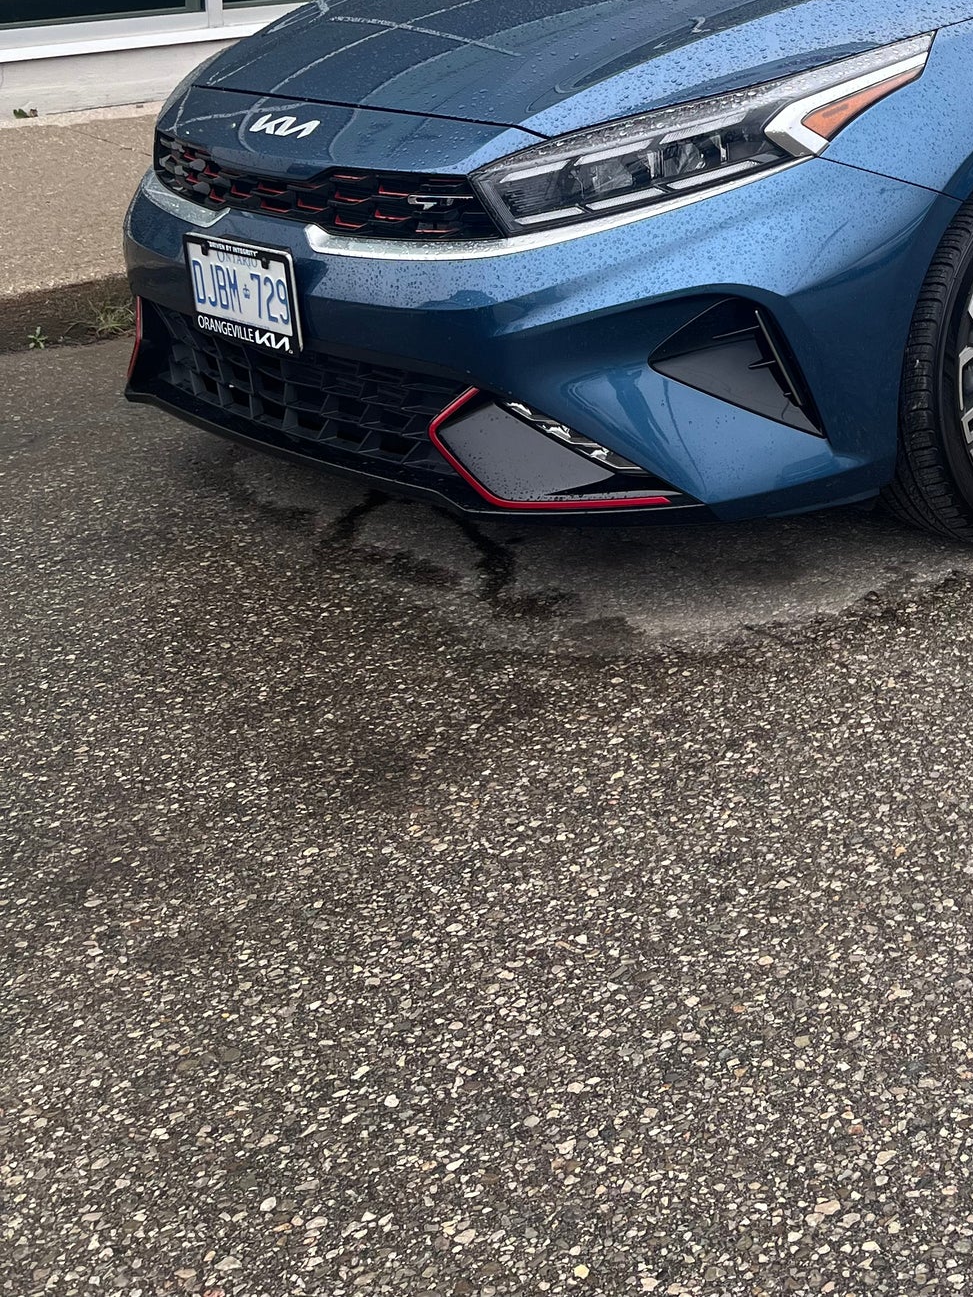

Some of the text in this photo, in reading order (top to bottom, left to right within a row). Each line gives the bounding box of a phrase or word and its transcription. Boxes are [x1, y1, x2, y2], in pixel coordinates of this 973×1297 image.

[192, 259, 290, 326] DJBM 729
[197, 314, 255, 343] ORANGEVILLE
